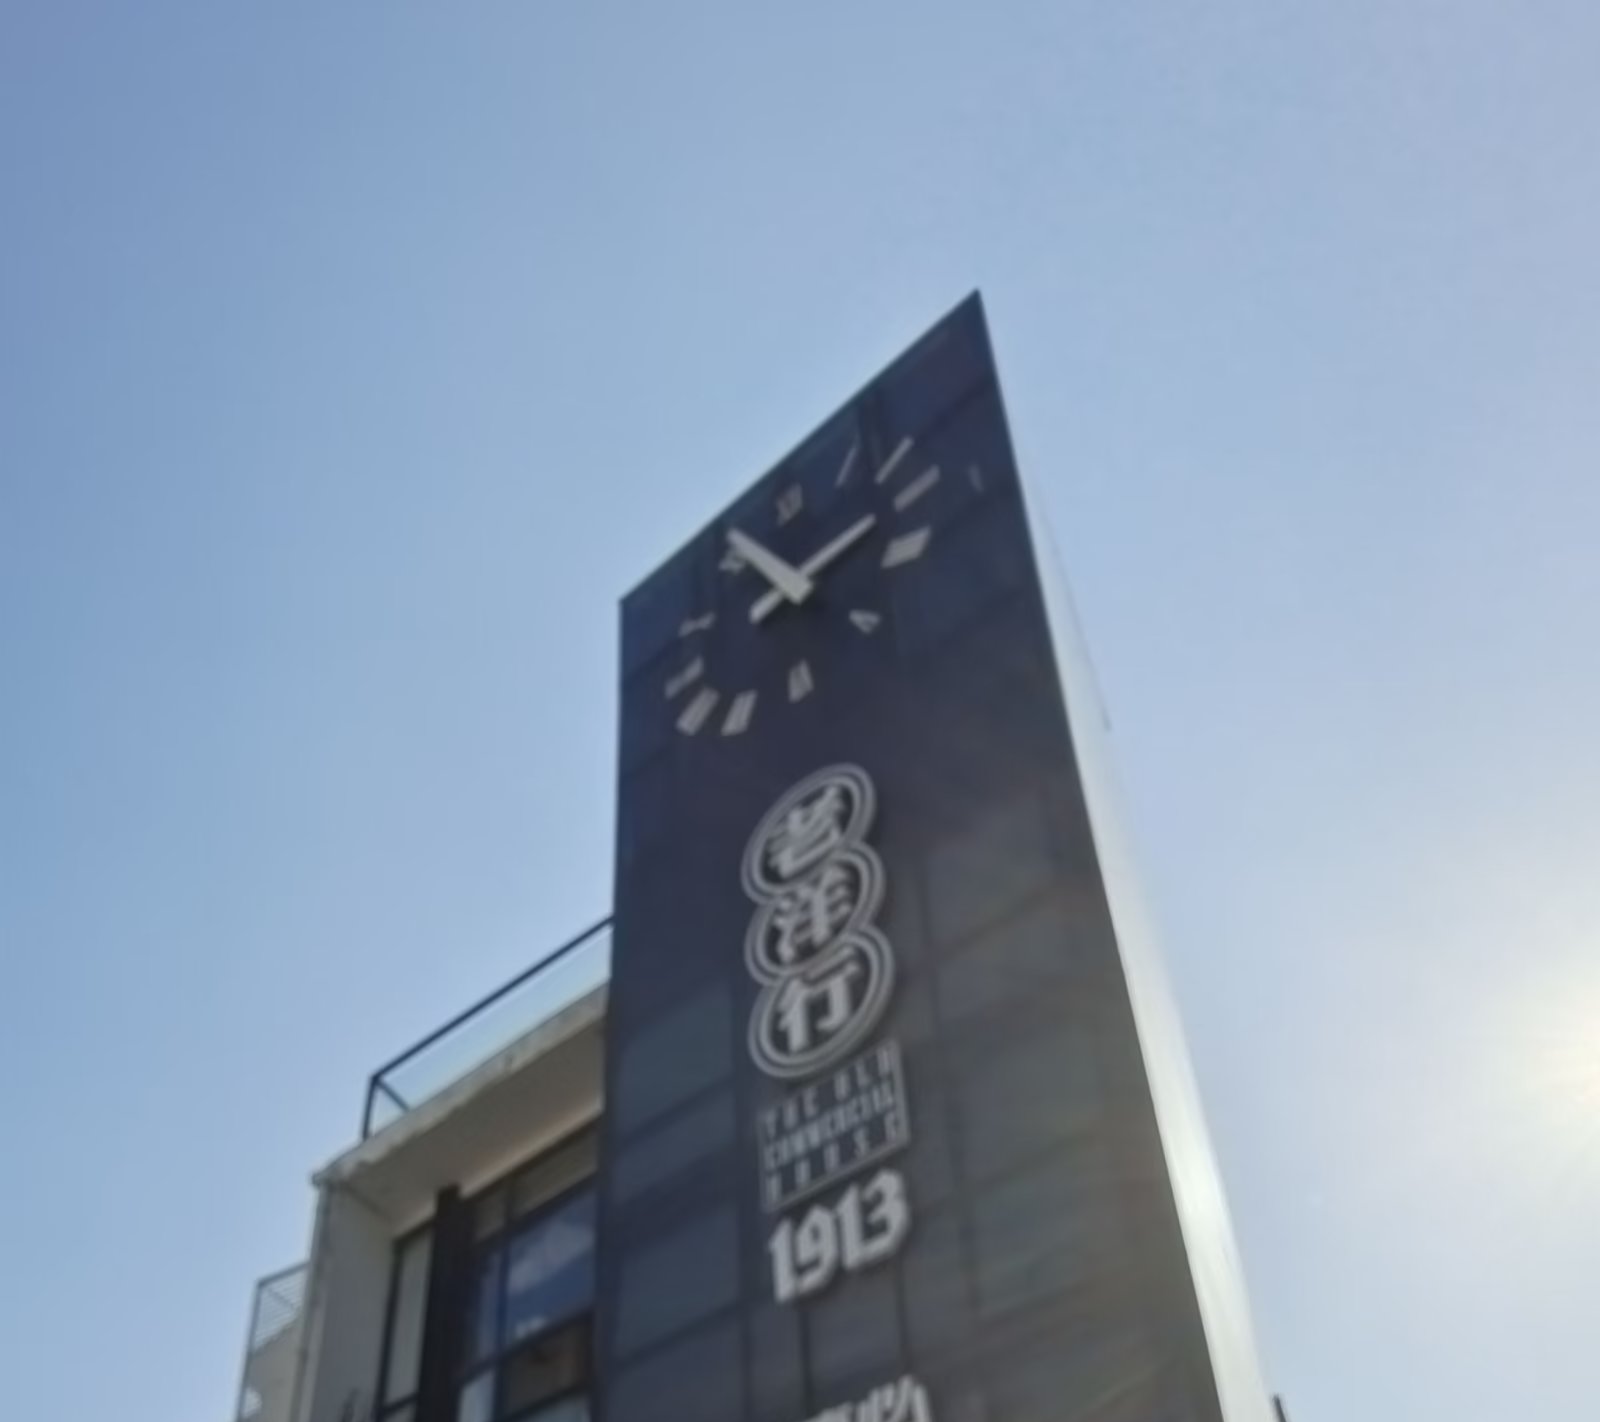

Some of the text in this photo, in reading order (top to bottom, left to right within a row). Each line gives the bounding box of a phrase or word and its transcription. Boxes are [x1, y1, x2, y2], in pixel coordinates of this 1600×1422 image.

[764, 782, 864, 1054] 老洋行
[767, 1167, 910, 1305] 1913
